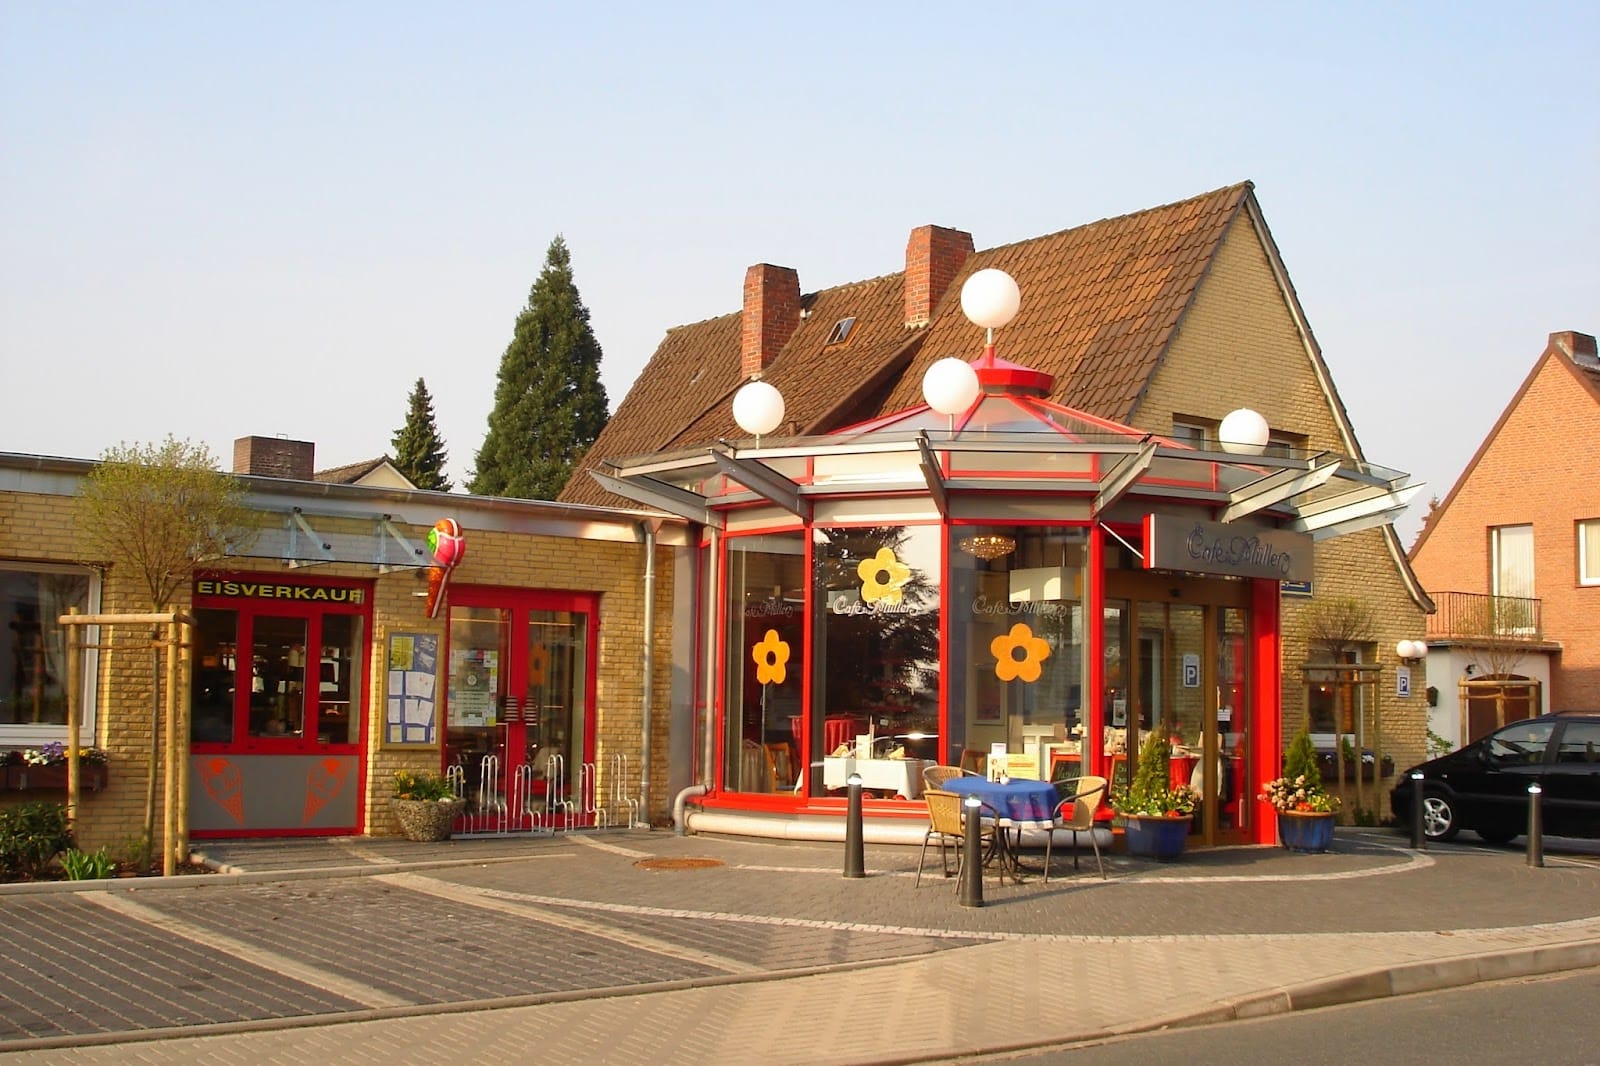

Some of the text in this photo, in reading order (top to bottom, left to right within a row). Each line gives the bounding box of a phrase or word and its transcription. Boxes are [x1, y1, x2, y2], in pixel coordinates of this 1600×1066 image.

[1229, 536, 1290, 574] Müller
[198, 582, 363, 603] EISVERKAUF
[1186, 667, 1196, 684] P
[1401, 678, 1408, 691] P
